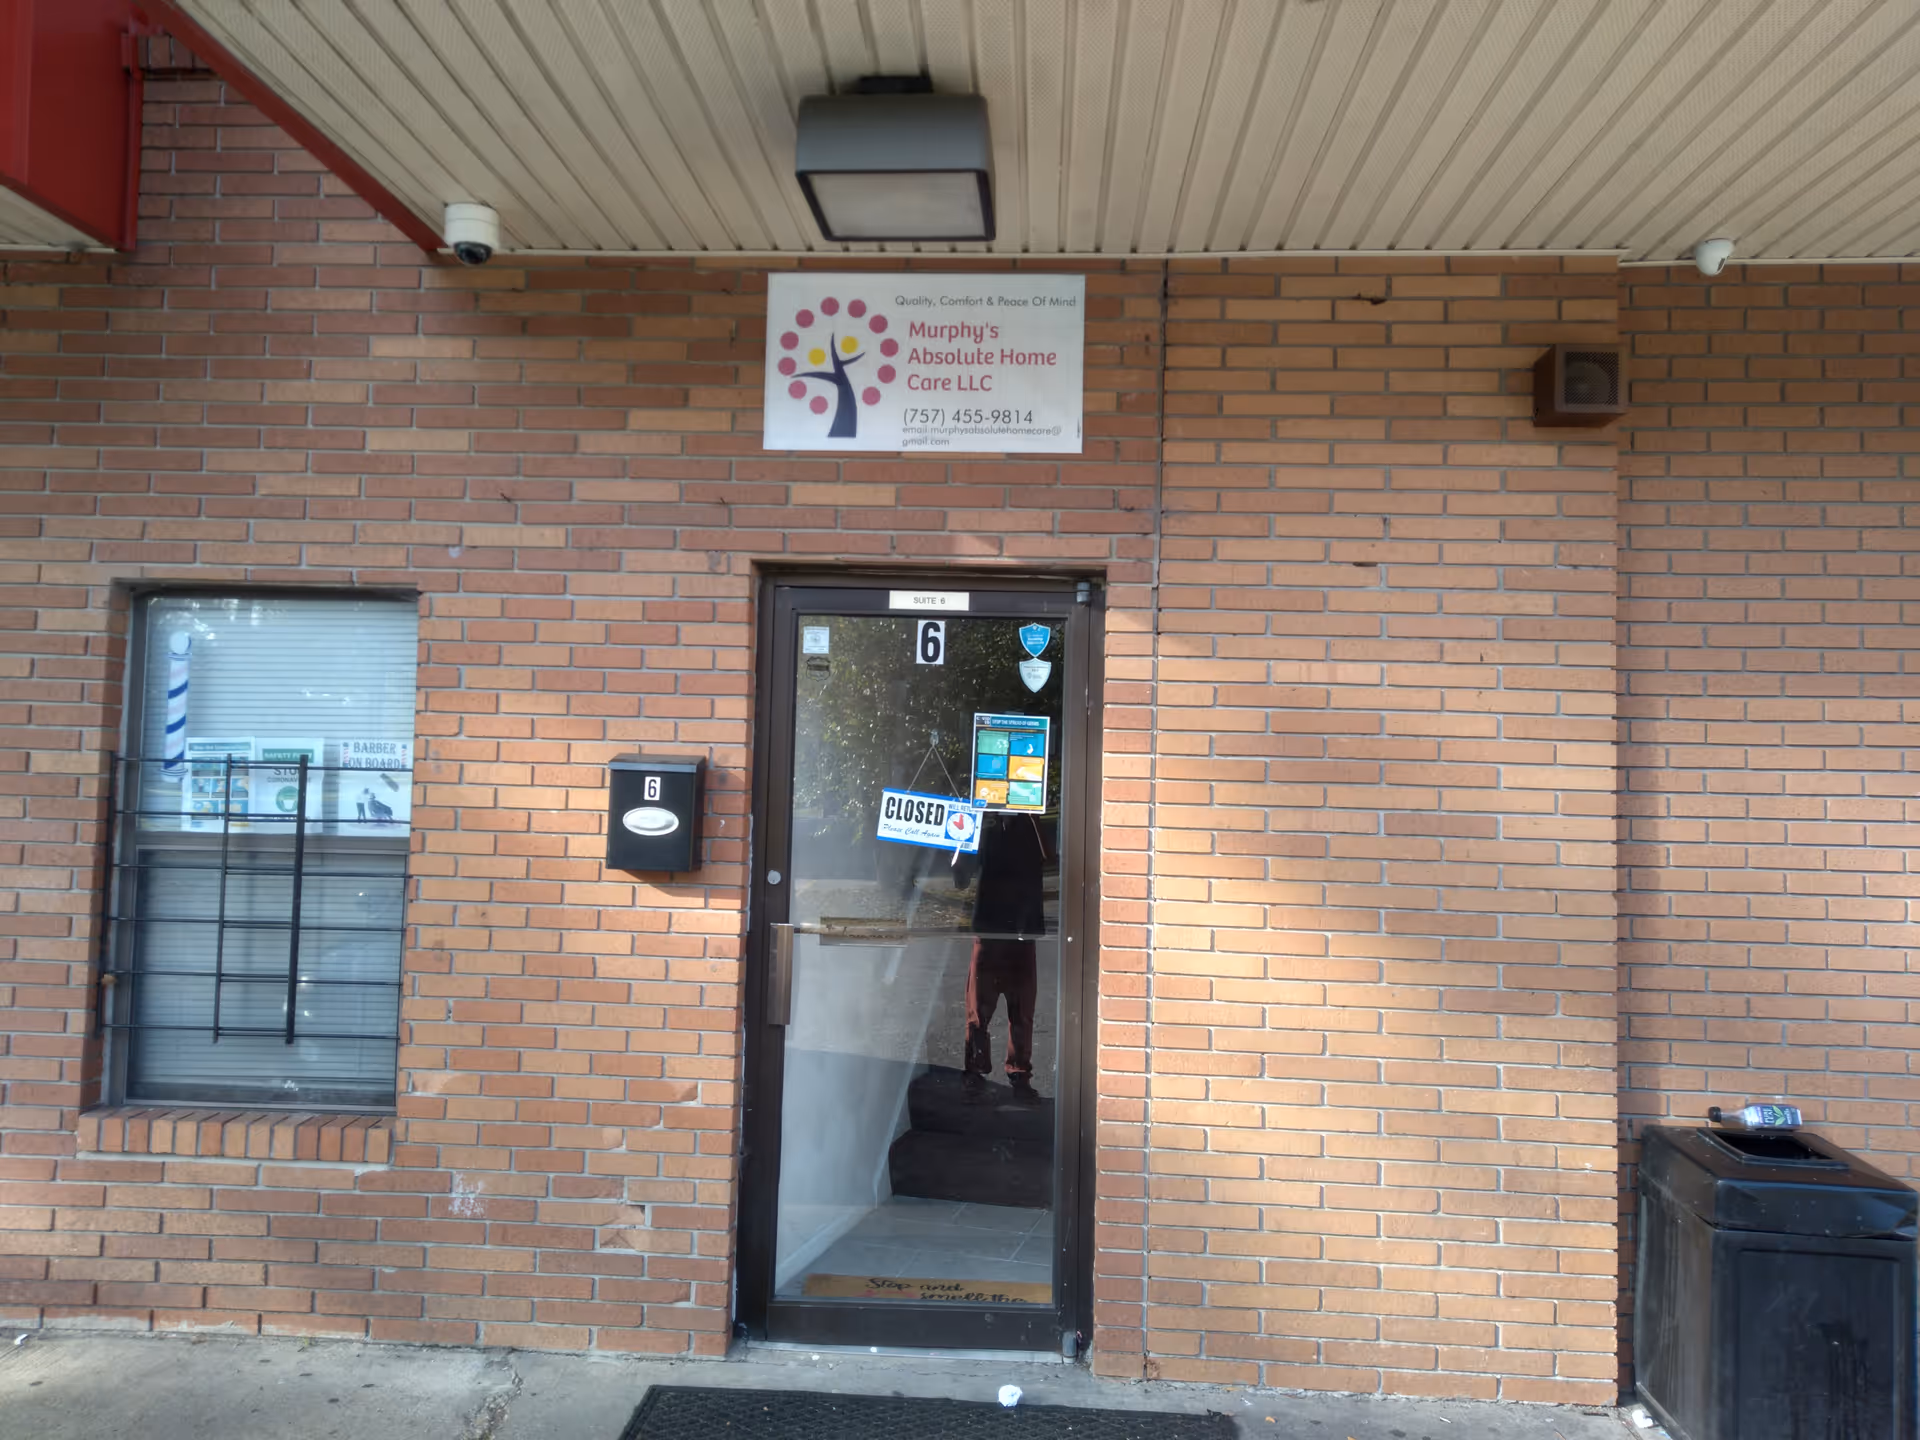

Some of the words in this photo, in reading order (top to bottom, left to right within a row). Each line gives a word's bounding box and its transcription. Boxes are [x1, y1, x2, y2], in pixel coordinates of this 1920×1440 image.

[895, 295, 936, 308] Quality,
[939, 295, 983, 306] Comfort
[986, 296, 994, 306] &
[998, 296, 1028, 306] Peace
[1032, 296, 1047, 306] Of
[1049, 296, 1076, 307] Mind
[909, 320, 999, 344] Murphy's
[907, 347, 994, 365] Absolute
[1000, 348, 1057, 366] Home
[907, 374, 951, 391] Care
[957, 374, 993, 391] LLC
[903, 408, 946, 426] (757)
[952, 409, 1033, 424] 455-9814
[902, 437, 950, 447] gmail.com
[913, 596, 937, 605] SUITE
[940, 597, 946, 605] 6
[921, 621, 941, 663] 6
[353, 741, 396, 755] BARBER
[348, 757, 361, 768] ON
[365, 757, 400, 769] BOARD
[648, 778, 657, 798] 6
[885, 796, 945, 826] CLOSED
[883, 823, 903, 833] Please
[905, 827, 920, 836] Call
[920, 829, 940, 838] Again
[866, 1277, 913, 1292] Stop
[919, 1283, 964, 1292] and
